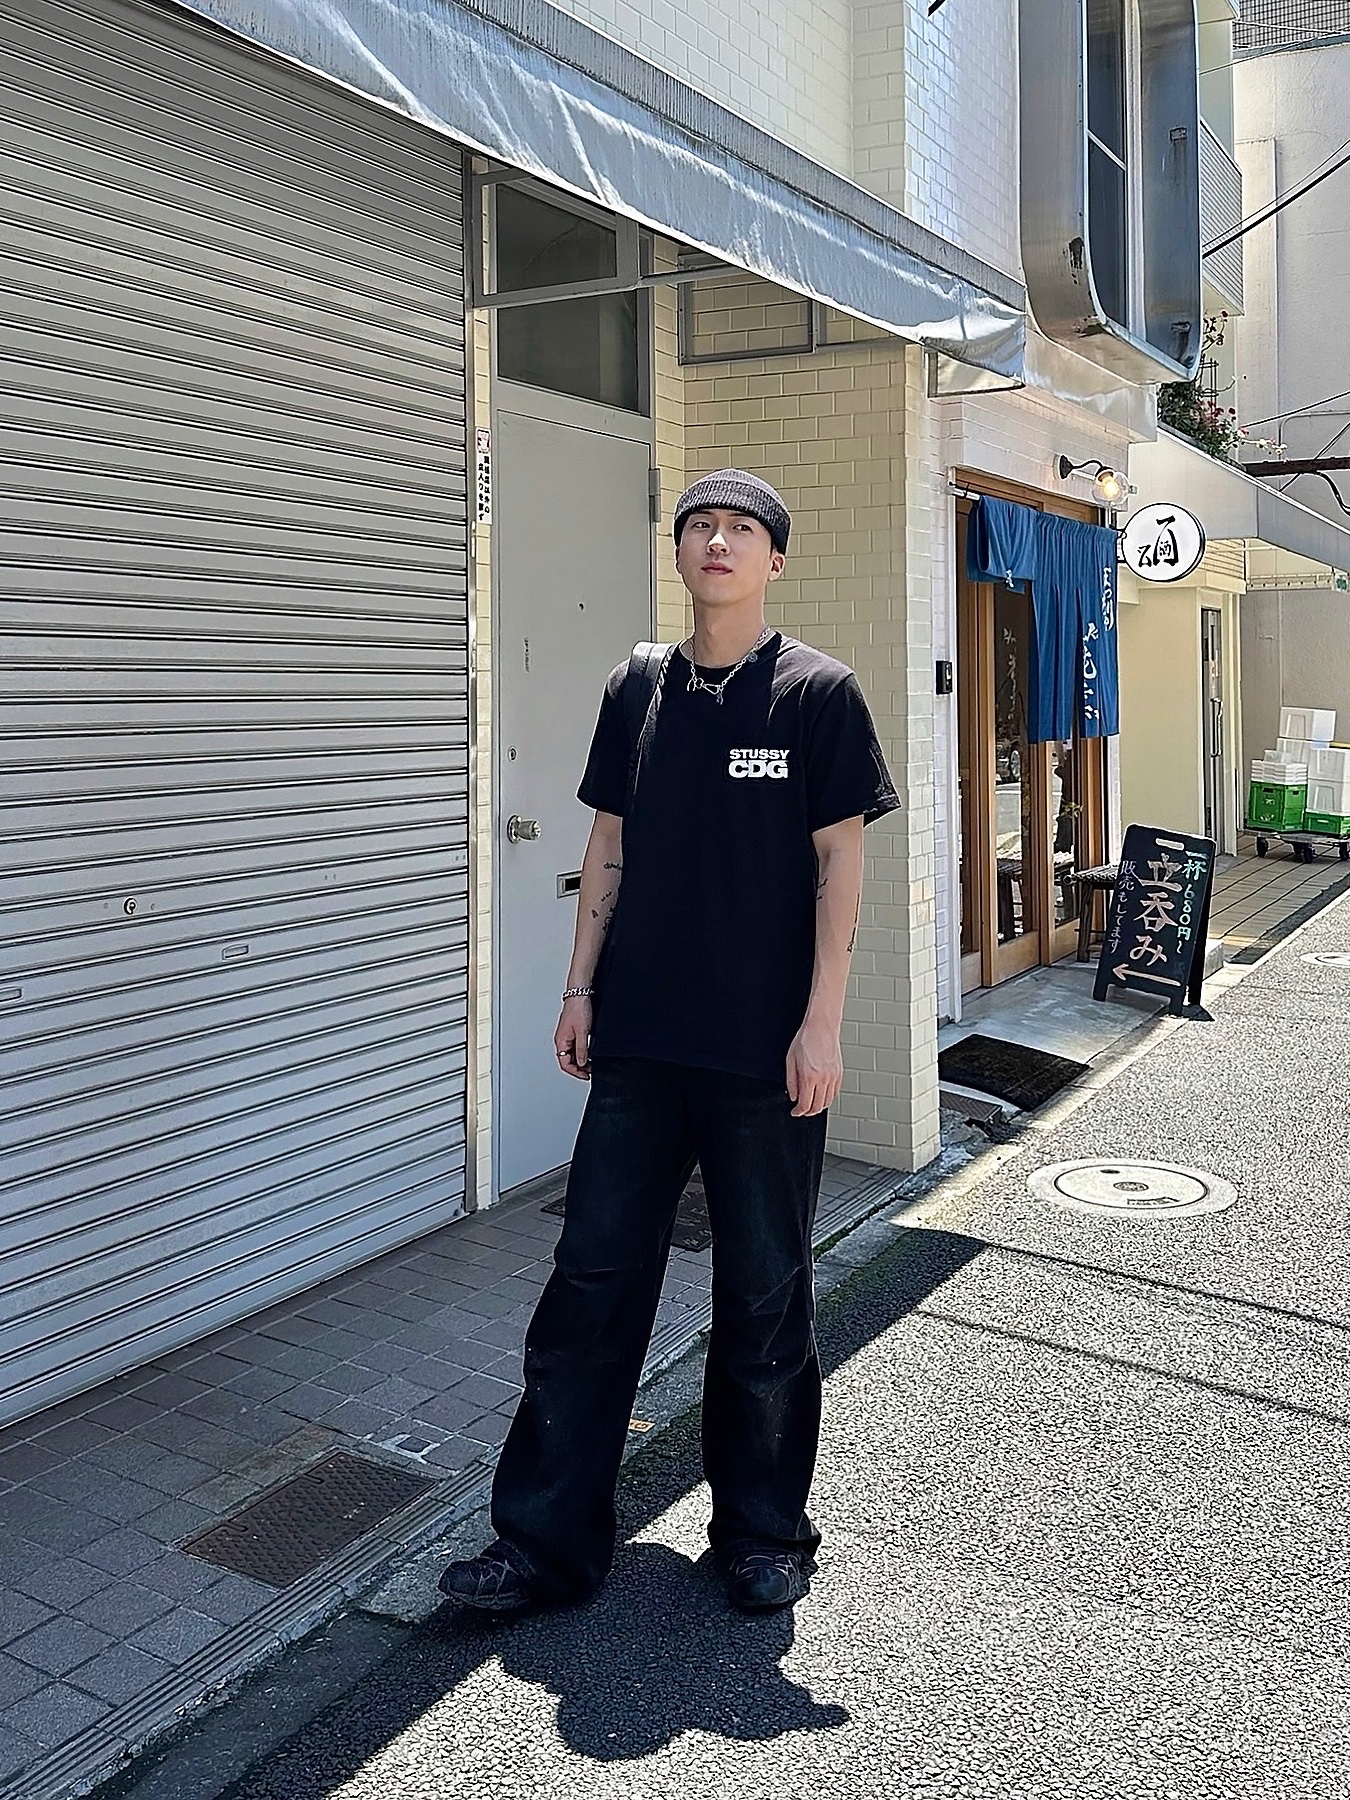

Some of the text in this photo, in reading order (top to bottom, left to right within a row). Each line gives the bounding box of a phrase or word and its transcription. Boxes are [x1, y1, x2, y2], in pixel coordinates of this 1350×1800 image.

[728, 759, 789, 779] CDG
[729, 748, 790, 760] STUSSY
[1107, 859, 1140, 954] 販売もしてます
[1129, 852, 1184, 967] 立呑み
